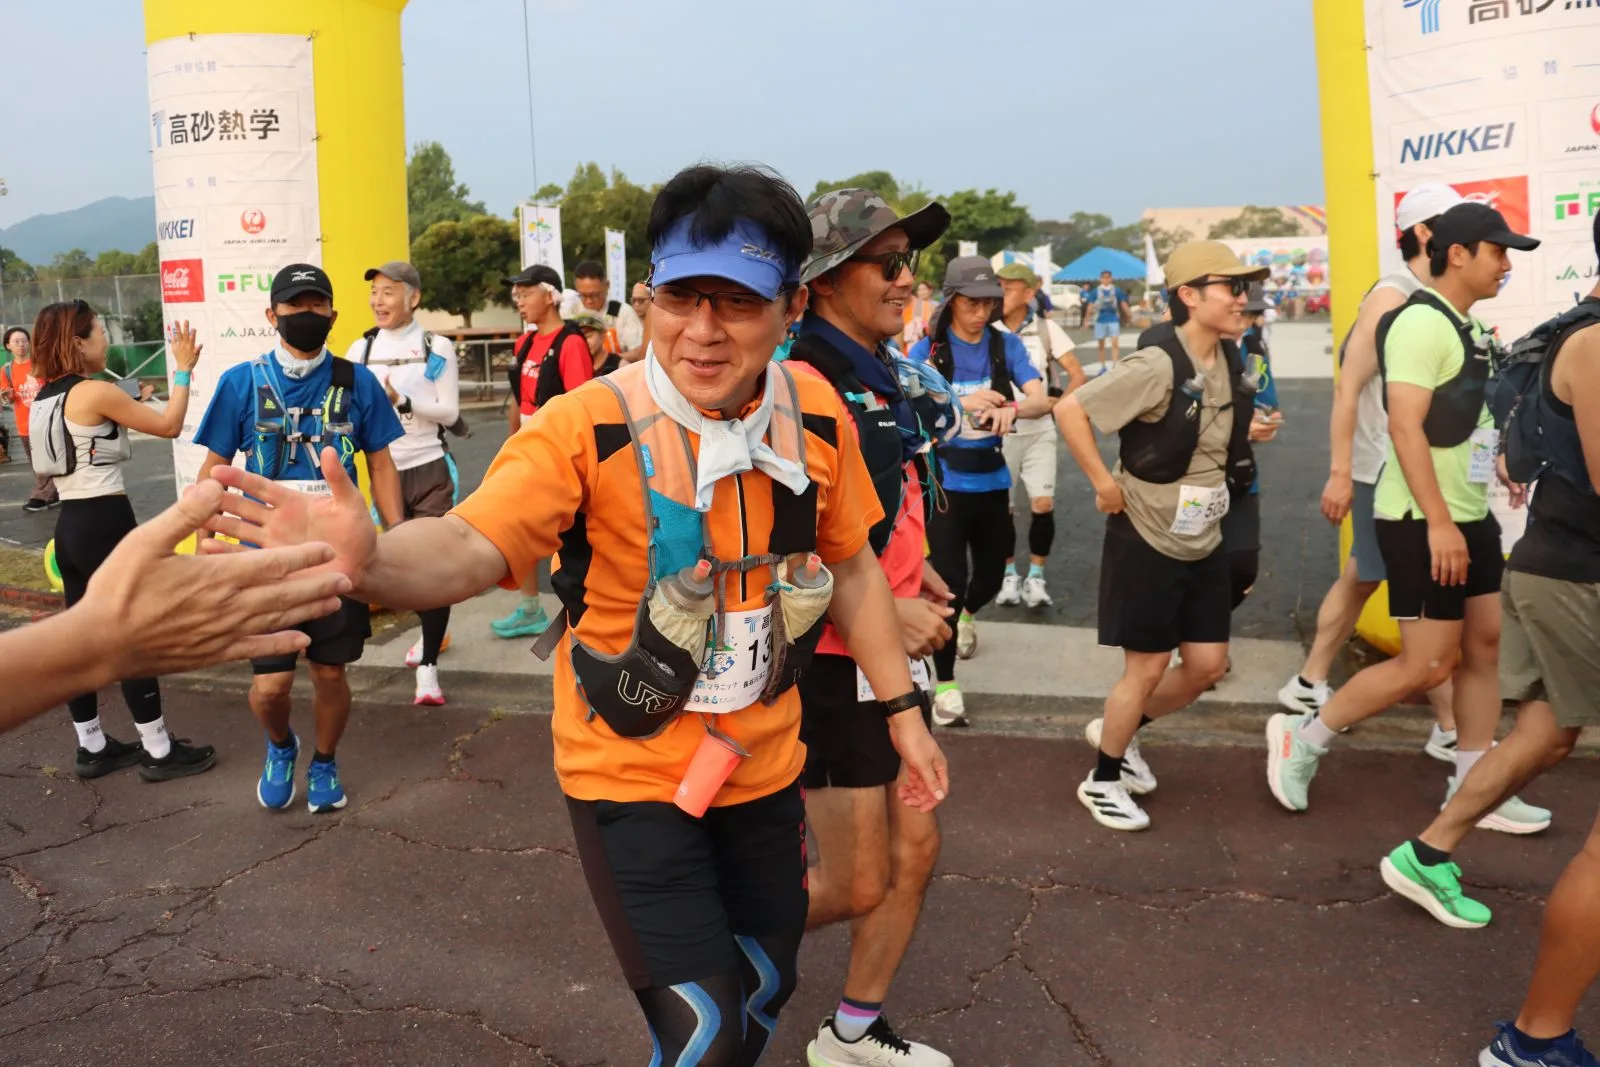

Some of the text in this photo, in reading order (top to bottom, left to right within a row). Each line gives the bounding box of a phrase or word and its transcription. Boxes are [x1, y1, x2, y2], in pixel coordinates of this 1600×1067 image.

[169, 108, 280, 145] 高砂熱学
[1400, 122, 1516, 164] NIKKEI
